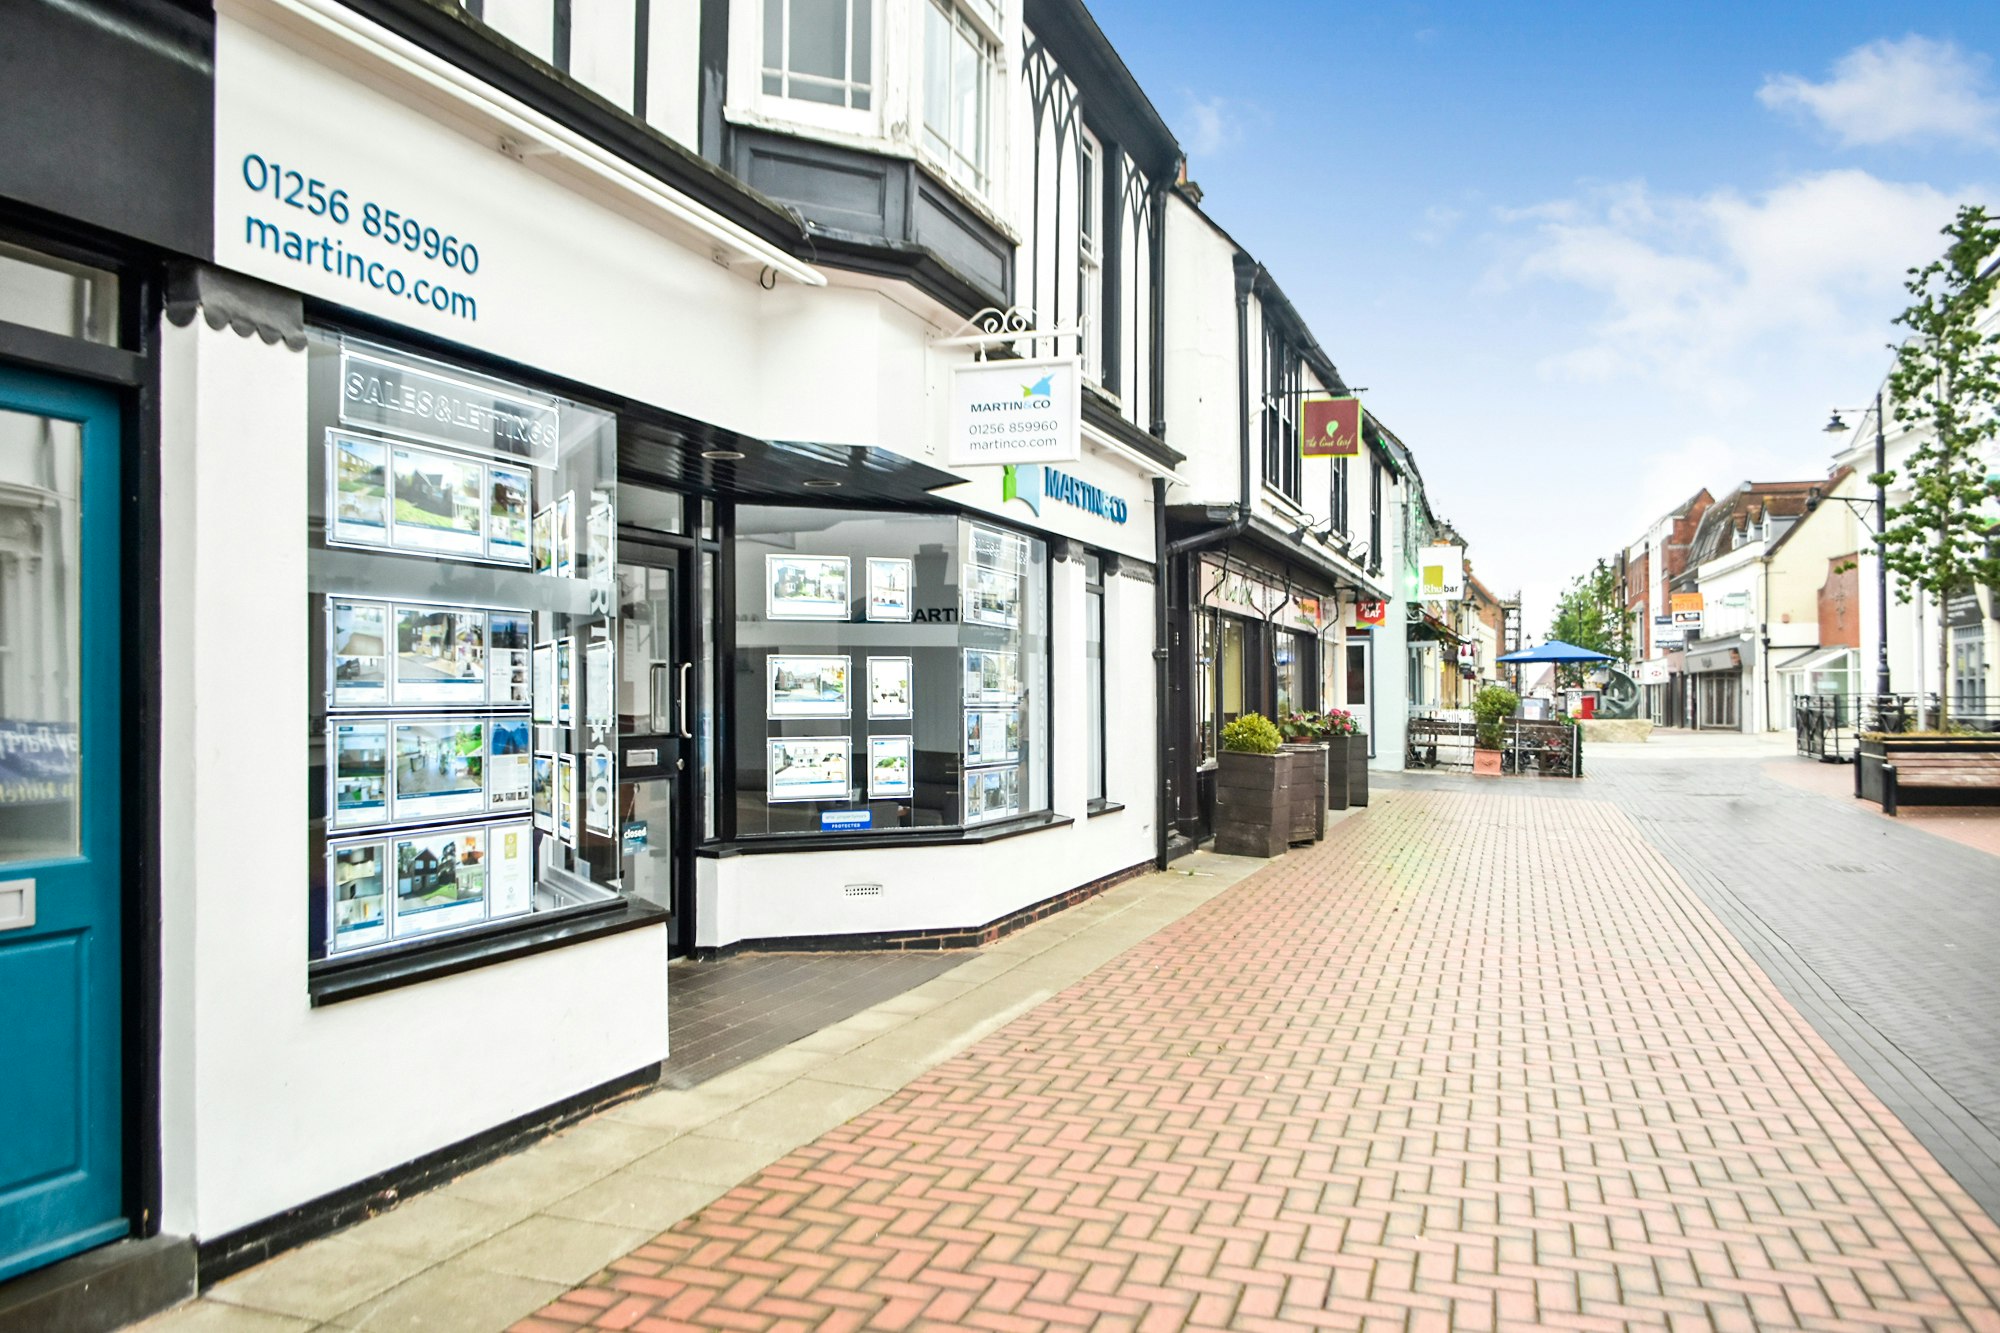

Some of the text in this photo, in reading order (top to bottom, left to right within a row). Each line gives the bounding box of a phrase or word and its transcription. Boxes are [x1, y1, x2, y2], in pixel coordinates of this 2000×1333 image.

[243, 154, 478, 274] 01256 859960
[246, 216, 476, 321] martinco.com
[970, 399, 1051, 413] MARTIN&CO
[969, 420, 1058, 435] 01256 859960
[970, 437, 1057, 450] martinco.com
[624, 826, 647, 840] closed
